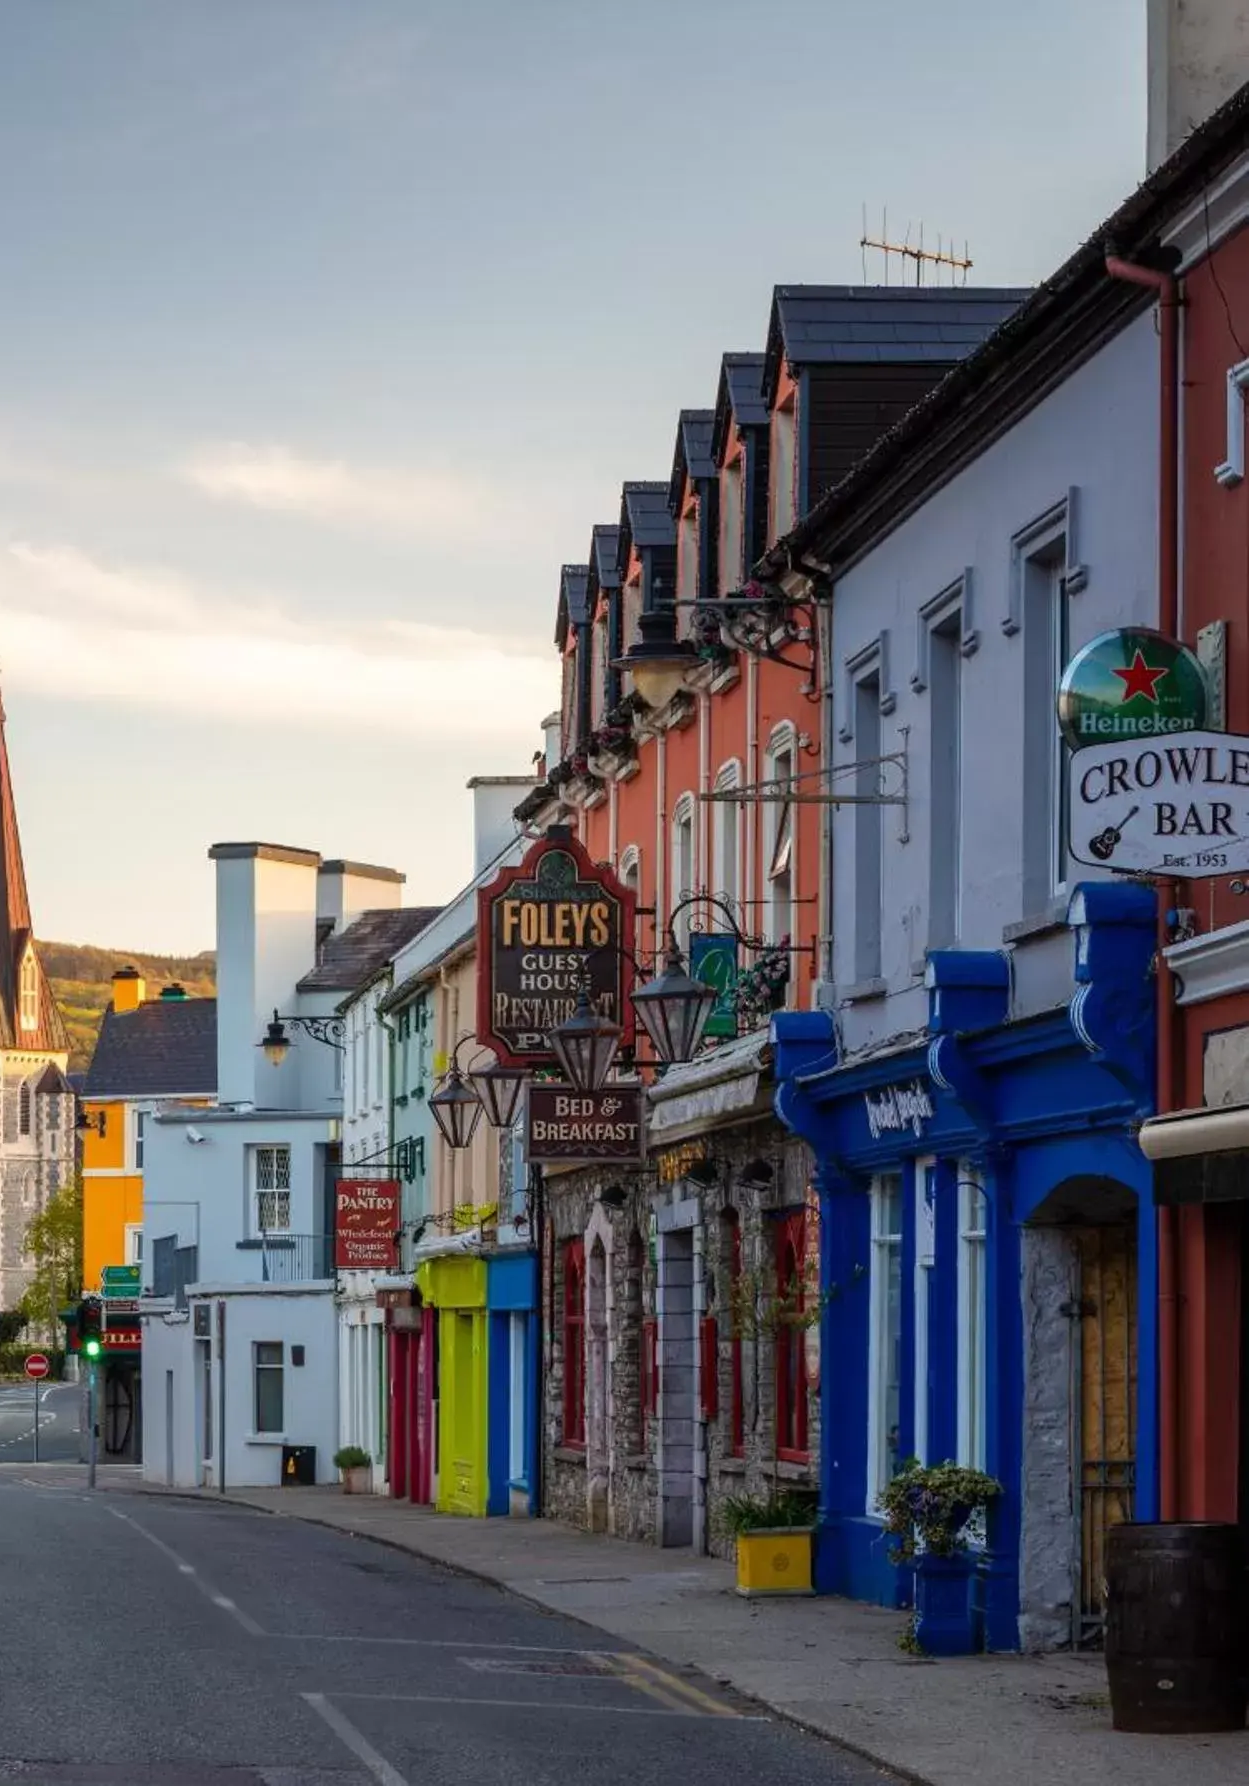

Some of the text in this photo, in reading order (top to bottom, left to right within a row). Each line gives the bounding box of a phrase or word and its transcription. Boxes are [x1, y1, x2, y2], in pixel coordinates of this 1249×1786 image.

[1080, 712, 1195, 734] Heineken
[1153, 802, 1238, 836] BAR
[1163, 854, 1228, 867] Est. 1953
[503, 899, 610, 947] FOLEYS
[521, 953, 592, 971] GUEST
[496, 992, 615, 1029] RESTAURT
[555, 1096, 623, 1117] BED &
[532, 1120, 639, 1141] BREAKFAST
[356, 1187, 378, 1197] THE
[337, 1194, 395, 1211] PANTRY
[345, 1241, 386, 1254] Organic
[348, 1251, 389, 1260] Produce
